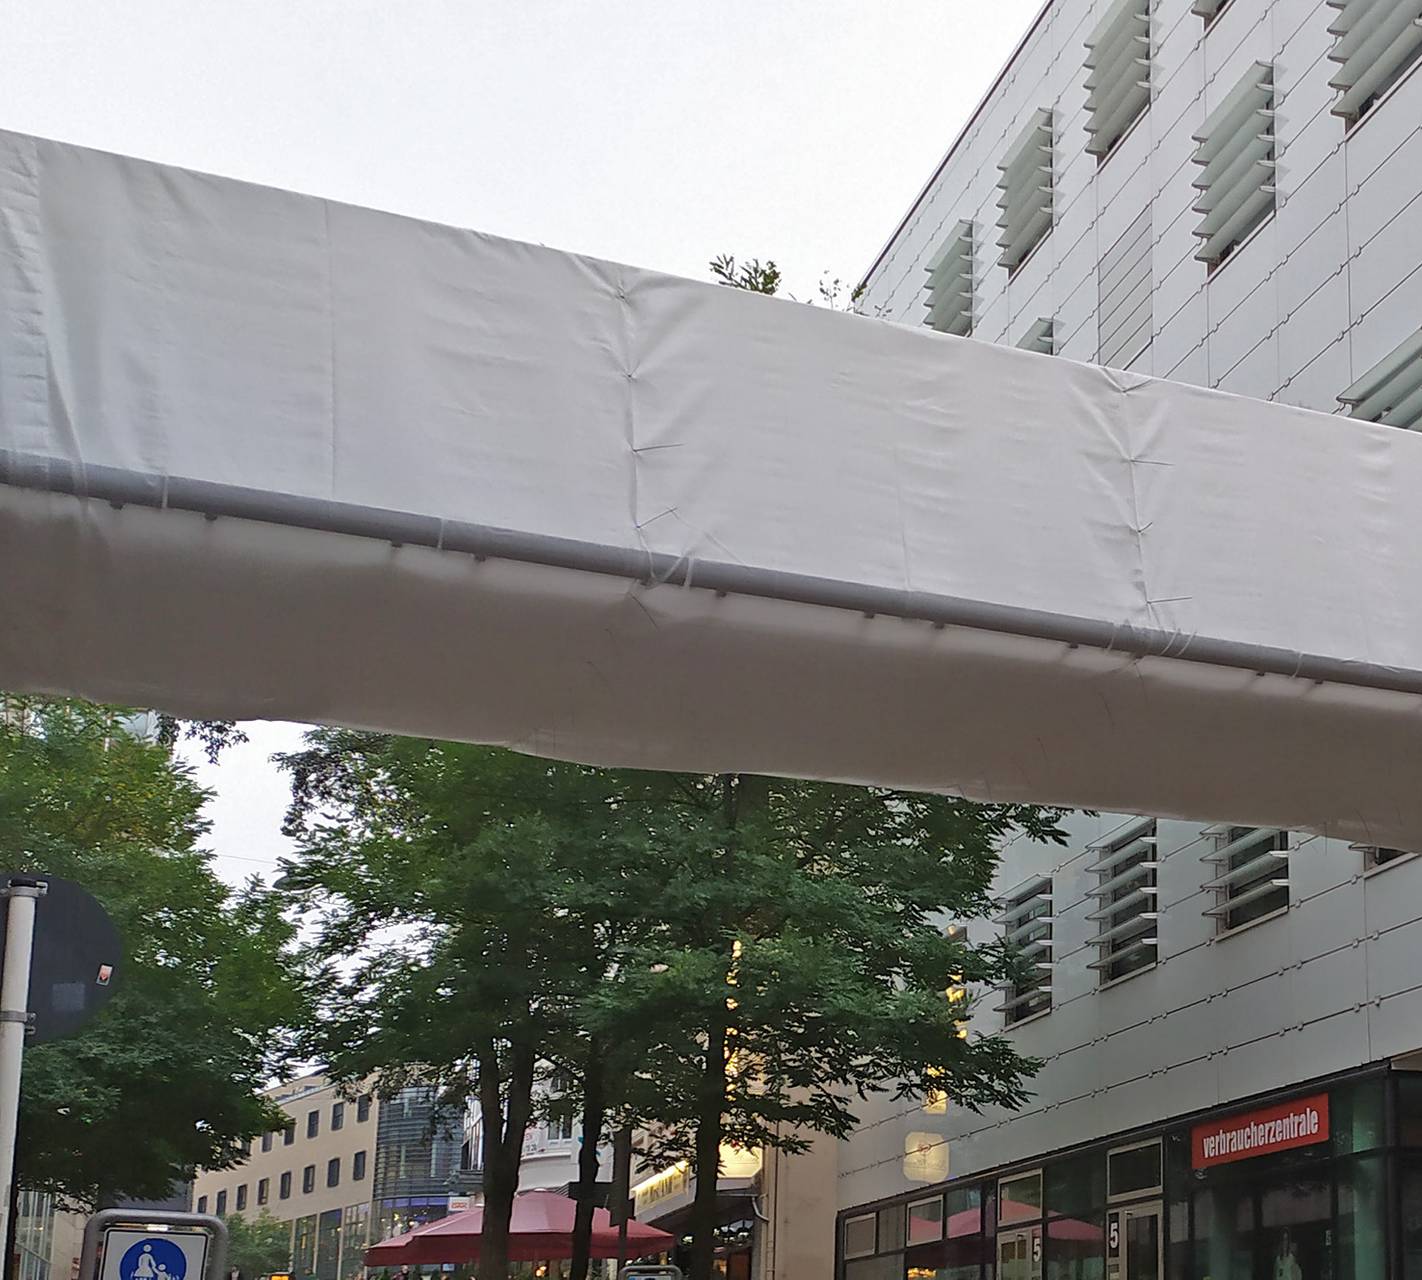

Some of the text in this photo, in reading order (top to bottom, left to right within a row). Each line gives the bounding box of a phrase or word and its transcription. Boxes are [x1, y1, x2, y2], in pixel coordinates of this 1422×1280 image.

[1202, 1107, 1319, 1158] verbraucherzentrale
[1109, 1222, 1119, 1249] 5
[1032, 1237, 1041, 1262] 5
